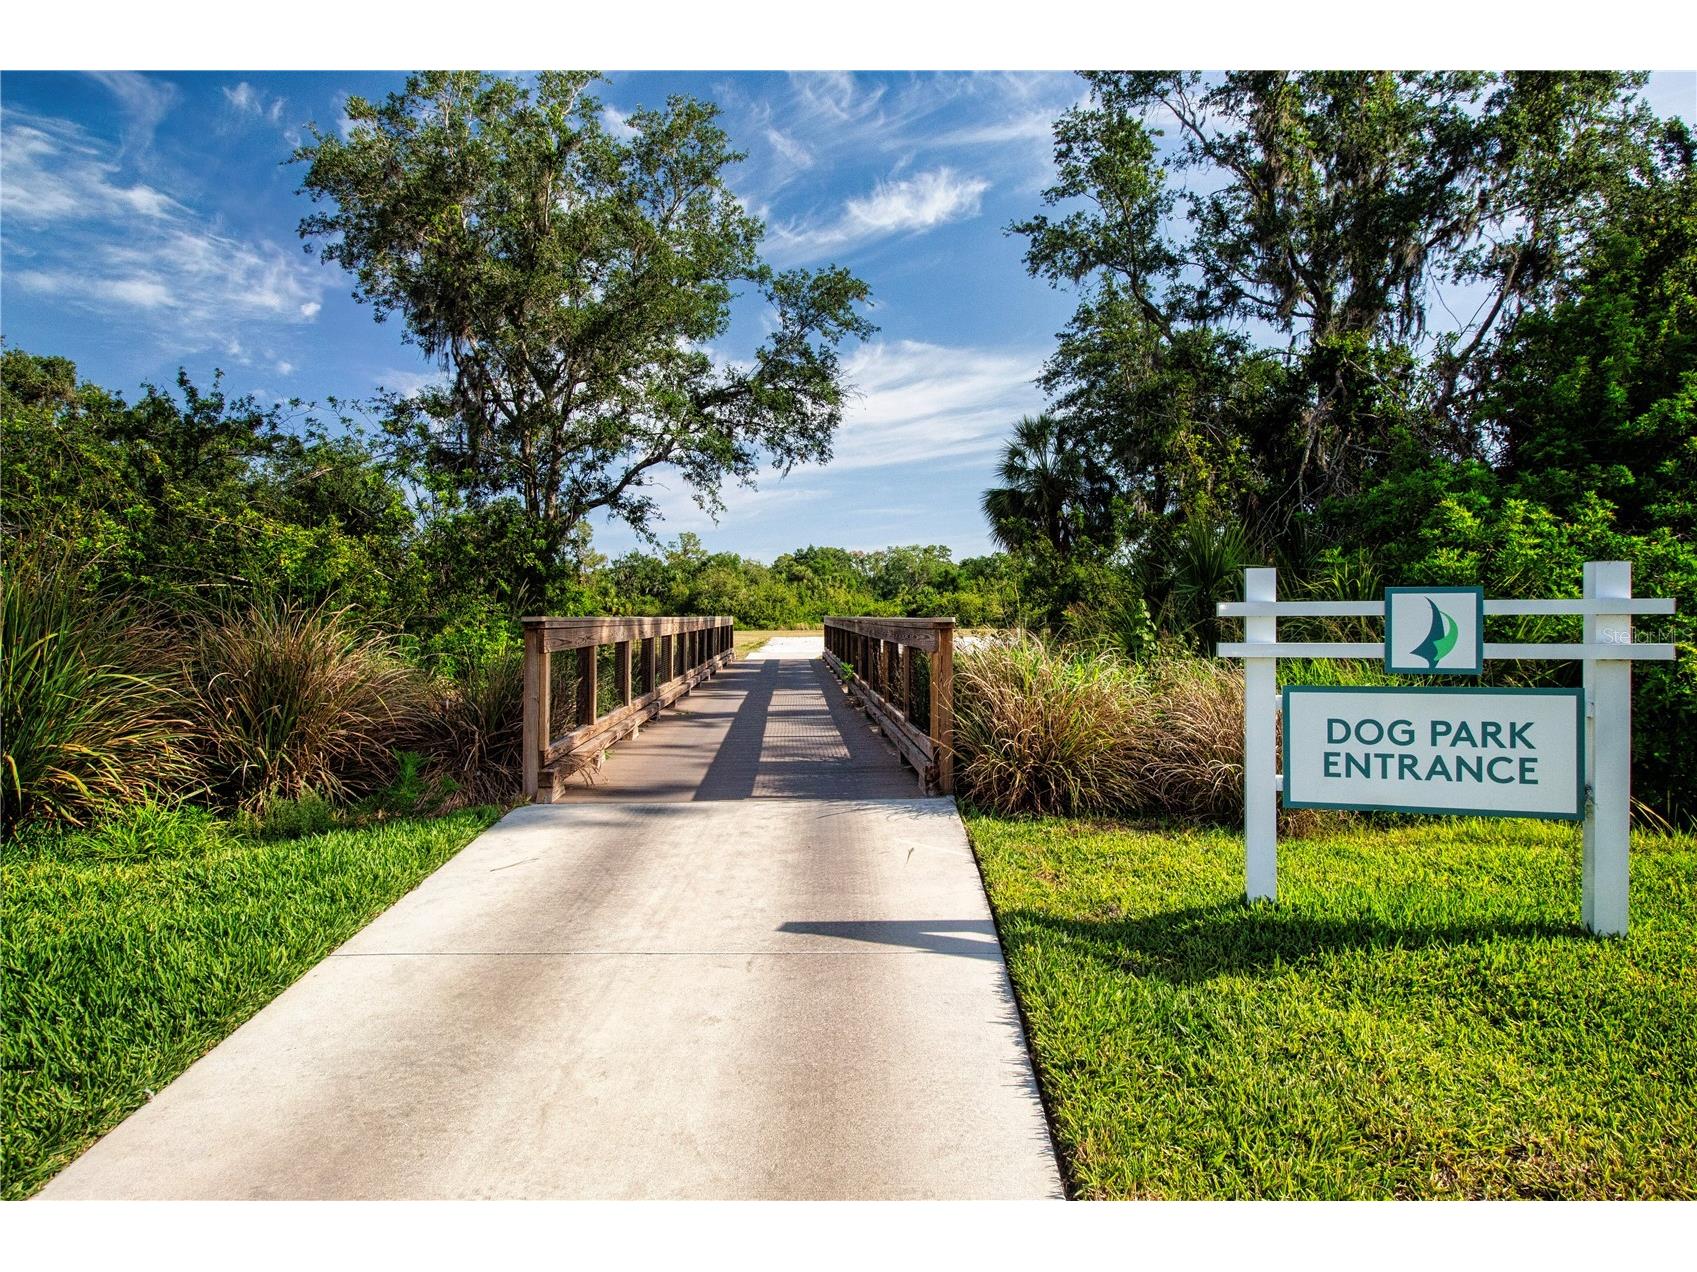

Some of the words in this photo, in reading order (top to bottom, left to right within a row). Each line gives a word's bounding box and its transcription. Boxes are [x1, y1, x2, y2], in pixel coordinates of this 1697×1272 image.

[1326, 718, 1416, 747] DOG
[1430, 719, 1537, 750] PARK
[1323, 751, 1539, 785] ENTRANCE
